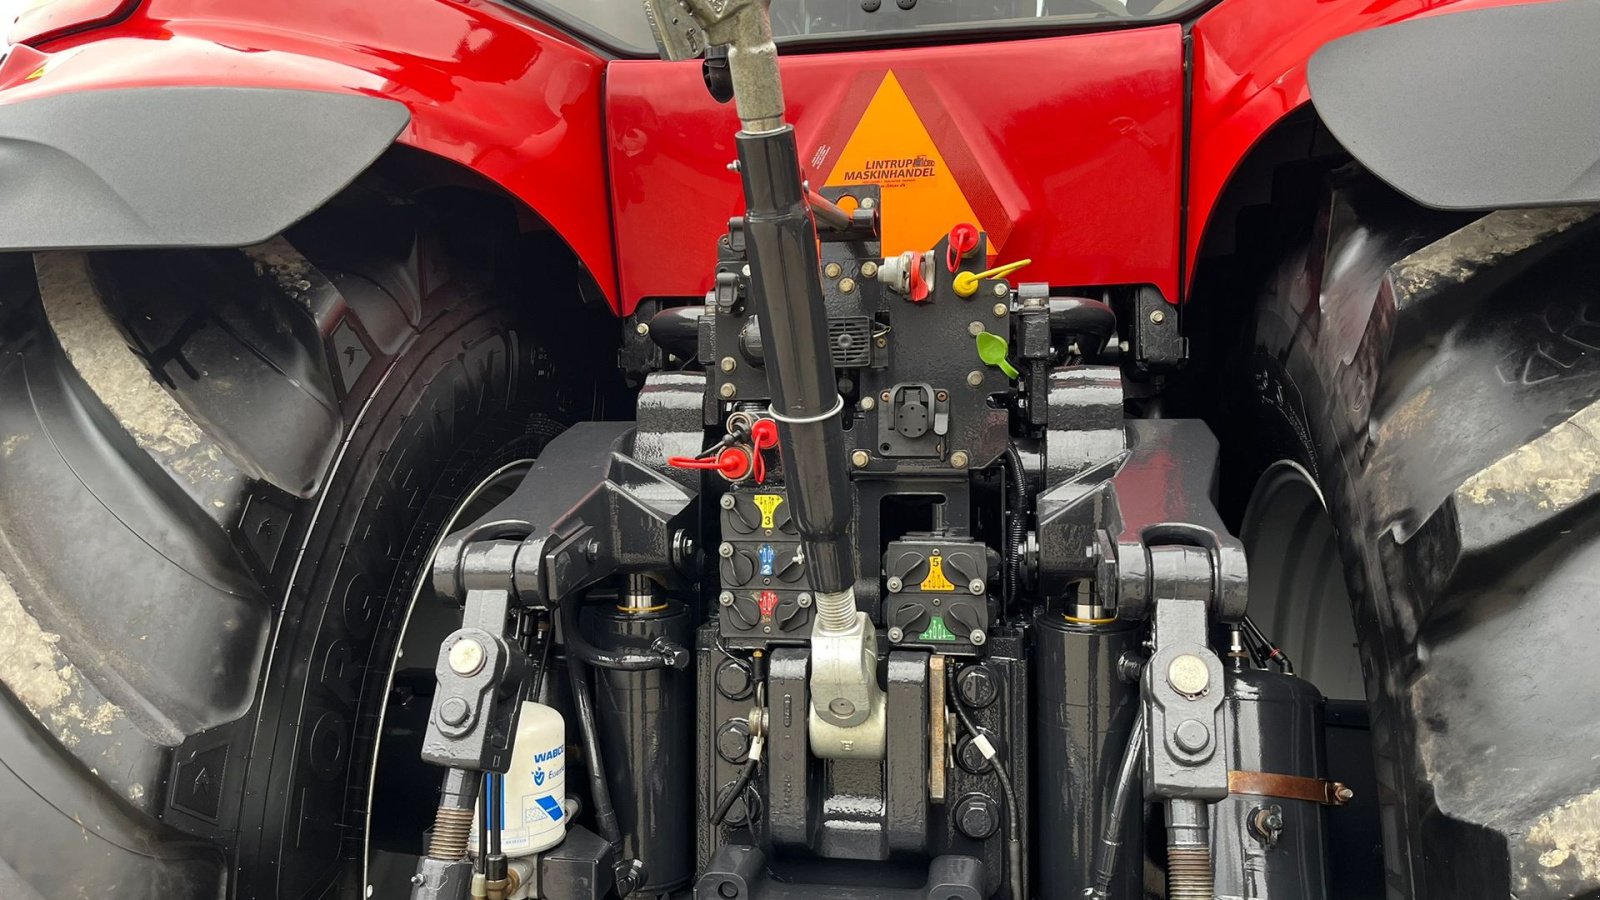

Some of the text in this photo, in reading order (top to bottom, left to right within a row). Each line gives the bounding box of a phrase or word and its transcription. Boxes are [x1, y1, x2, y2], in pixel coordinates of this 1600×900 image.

[865, 158, 912, 170] LINTRUP
[844, 167, 935, 181] MASKINHANDEL
[764, 516, 771, 526] 3
[932, 557, 940, 568] 5
[762, 564, 770, 574] 2
